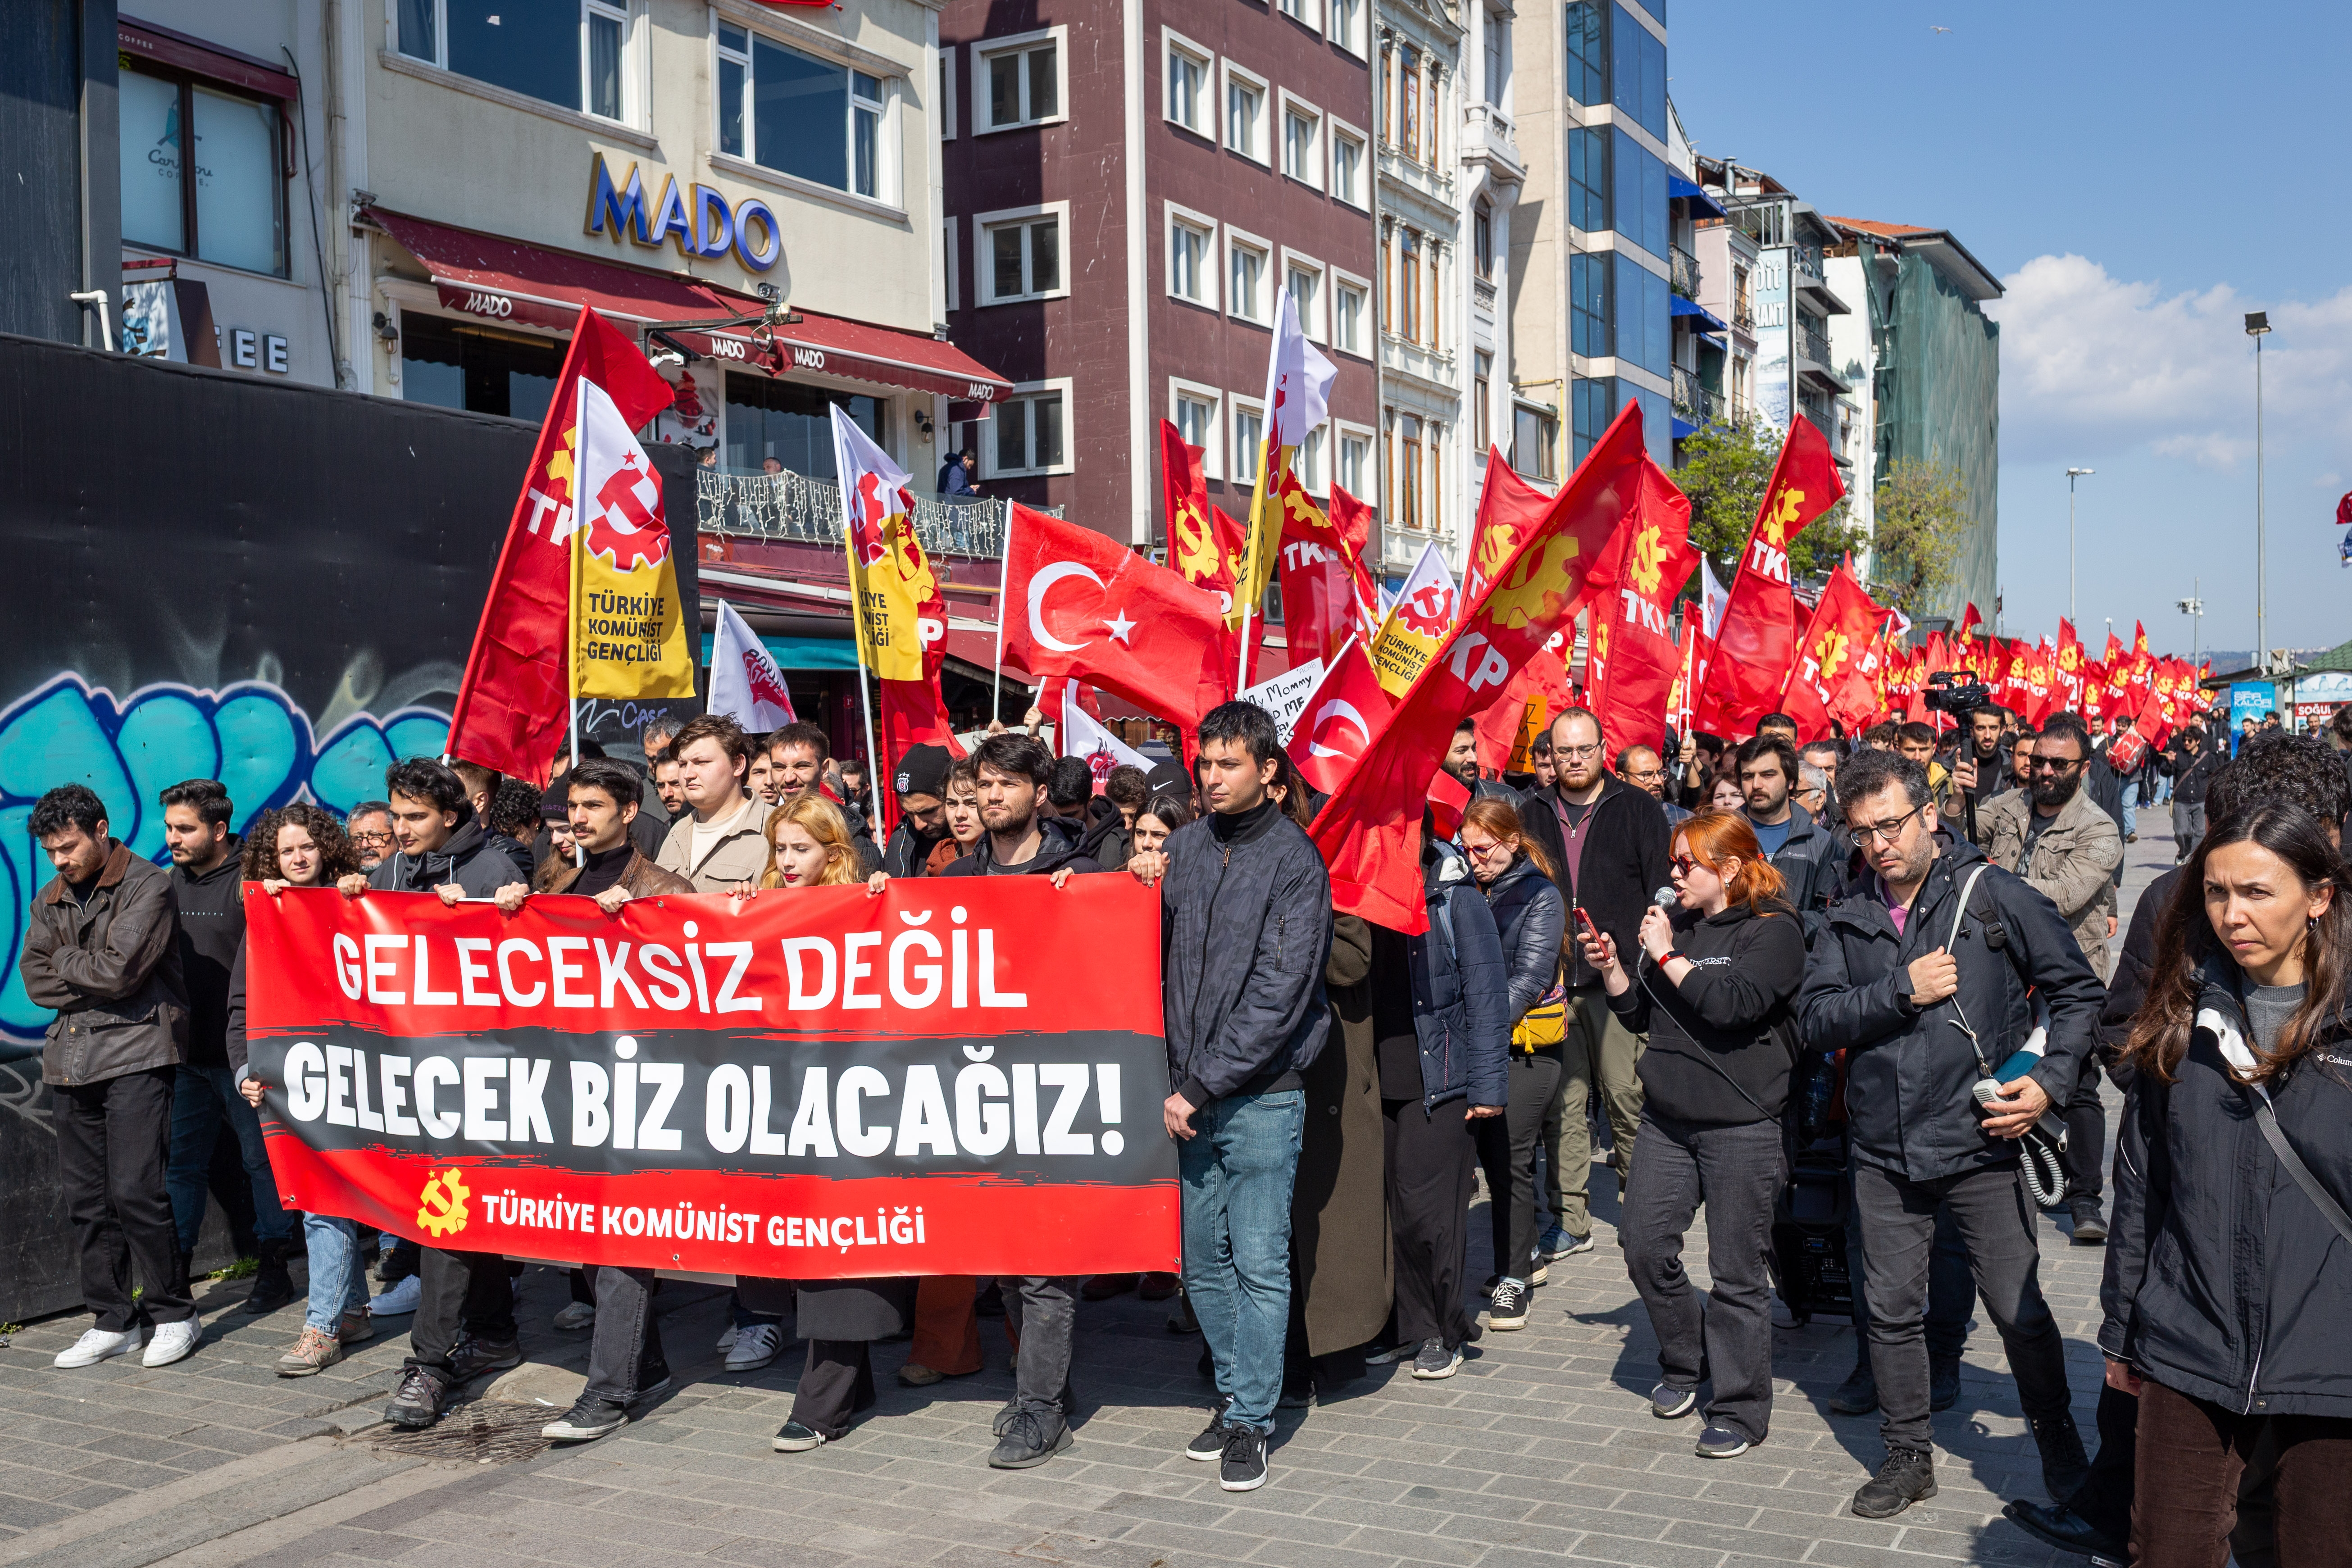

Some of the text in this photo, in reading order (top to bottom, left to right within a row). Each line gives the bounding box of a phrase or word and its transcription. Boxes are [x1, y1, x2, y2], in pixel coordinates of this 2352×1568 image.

[118, 33, 153, 49] COFFEE
[584, 152, 781, 274] MADO
[465, 291, 512, 317] MADO
[712, 337, 745, 359] MADO
[795, 347, 825, 369] MADO
[969, 382, 994, 400] MADO
[1751, 539, 1791, 584] TK
[588, 589, 664, 617] TÜRKİYE
[588, 618, 663, 638] KOMÜNİST
[587, 637, 662, 667] GENÇLİĞİ
[1378, 644, 1423, 672] KOMÜNİST
[1384, 633, 1428, 663] TÜRKİYE
[1266, 675, 1312, 702] Mommy
[2029, 682, 2048, 698] TKP
[2193, 693, 2209, 709] TKP
[333, 905, 1028, 1014] GELECEKSİZ DEĞİL
[283, 1035, 1124, 1158] GELECEK BİZ OLACAĞIZ!
[482, 1189, 926, 1254] TÜRKİYE KOMÜNİST GENÇLİĞİ
